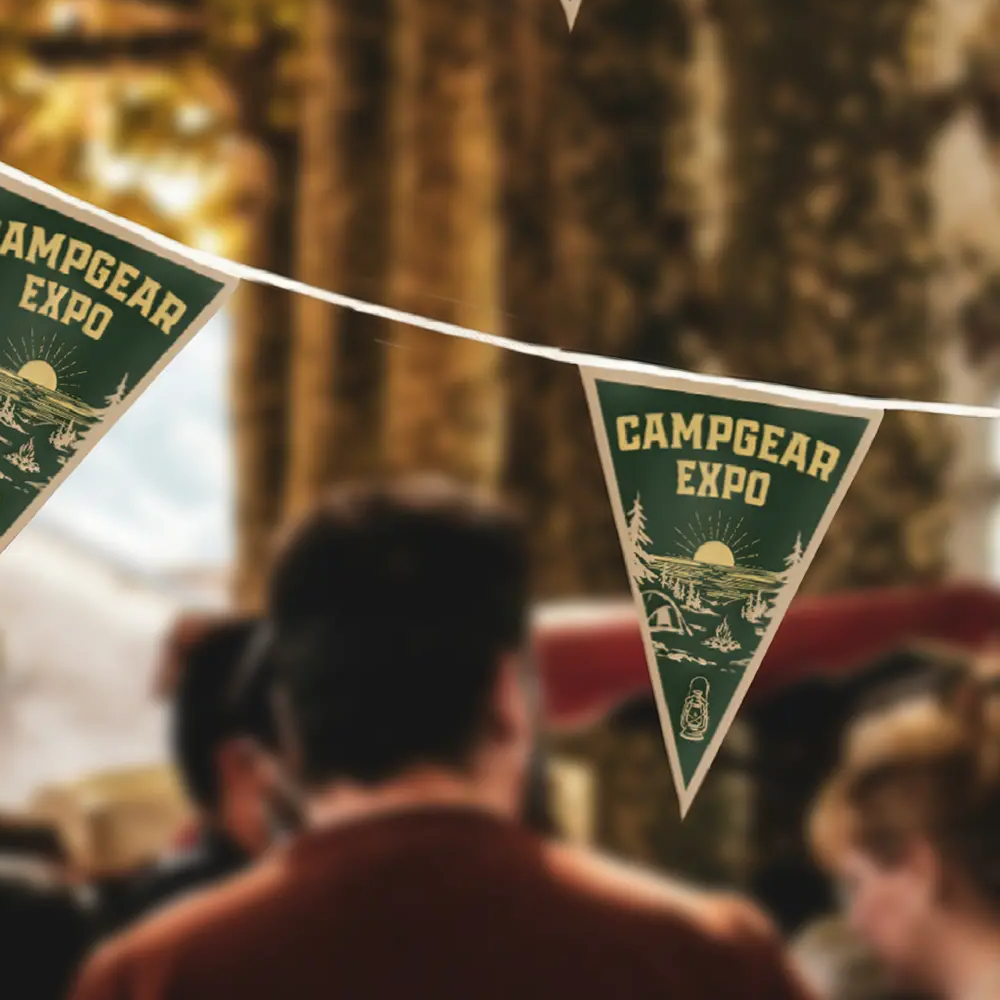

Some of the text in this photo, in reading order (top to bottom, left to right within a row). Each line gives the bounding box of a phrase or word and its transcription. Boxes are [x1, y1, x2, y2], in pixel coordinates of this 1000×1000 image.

[18, 274, 114, 341] EXPO
[616, 412, 841, 482] CAMPGEAR
[676, 460, 771, 507] EXPO
